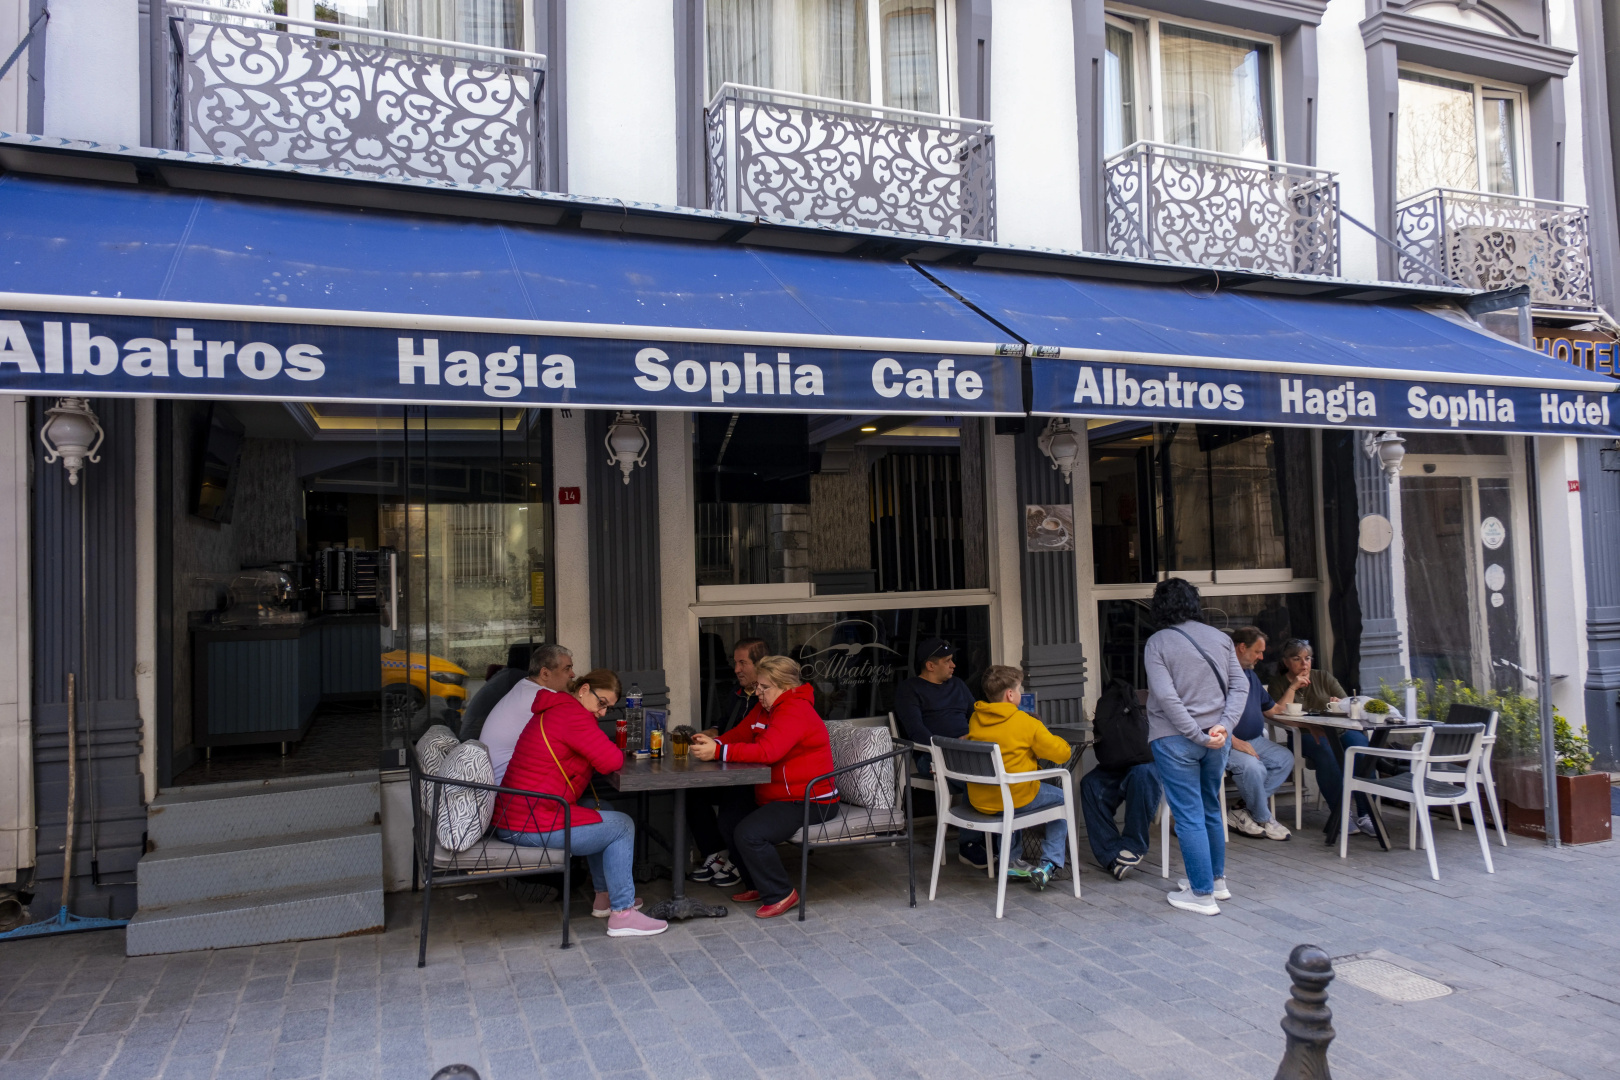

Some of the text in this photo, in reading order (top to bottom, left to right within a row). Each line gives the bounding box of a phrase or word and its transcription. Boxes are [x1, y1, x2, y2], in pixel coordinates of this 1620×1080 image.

[0, 319, 326, 381] Albatros
[633, 347, 825, 403] Sophia
[871, 357, 984, 400] Cafe
[1073, 366, 1610, 428] Albatros Hagia Sophia Hotel
[564, 491, 575, 501] 14
[800, 653, 892, 679] Albatros
